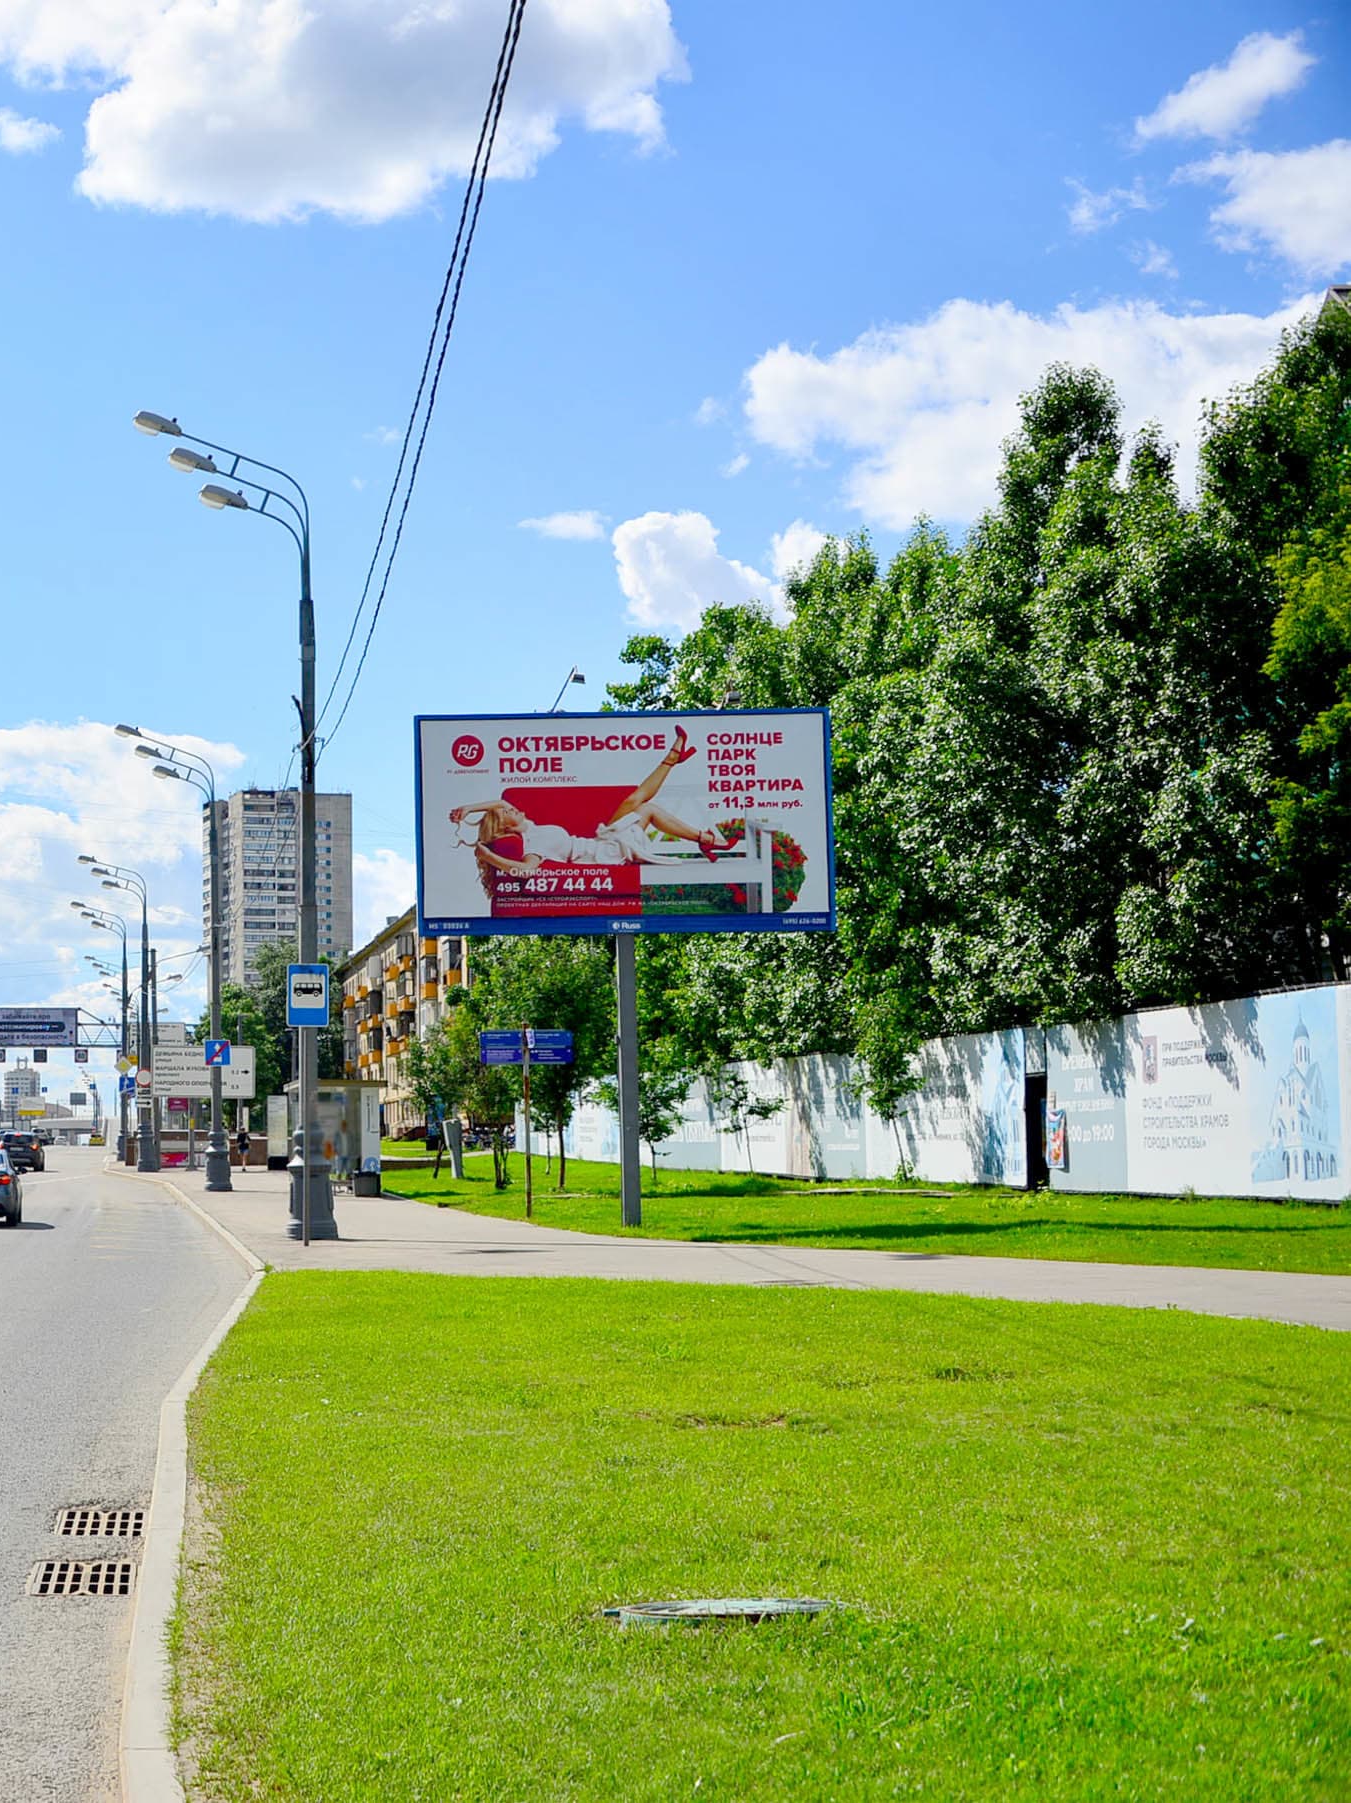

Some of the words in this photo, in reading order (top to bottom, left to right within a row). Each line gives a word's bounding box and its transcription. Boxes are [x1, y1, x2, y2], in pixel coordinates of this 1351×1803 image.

[498, 734, 666, 752] ОКТЯБРЬСКОЕ
[706, 732, 783, 746] СОЛНЦЕ
[707, 748, 757, 761] ПАРК
[499, 757, 563, 773] ПОЛЕ
[707, 764, 756, 777] ТВОЯ
[500, 776, 531, 784] ЖИЛОЙ
[708, 778, 804, 792] КВАРТИРА
[722, 796, 755, 810] 11,3
[781, 800, 803, 809] руб.
[510, 867, 580, 878] Октябрьское
[582, 868, 610, 876] поле
[496, 882, 521, 893] 495
[525, 877, 558, 892] 487
[563, 877, 586, 891] 44
[590, 877, 614, 891] 44
